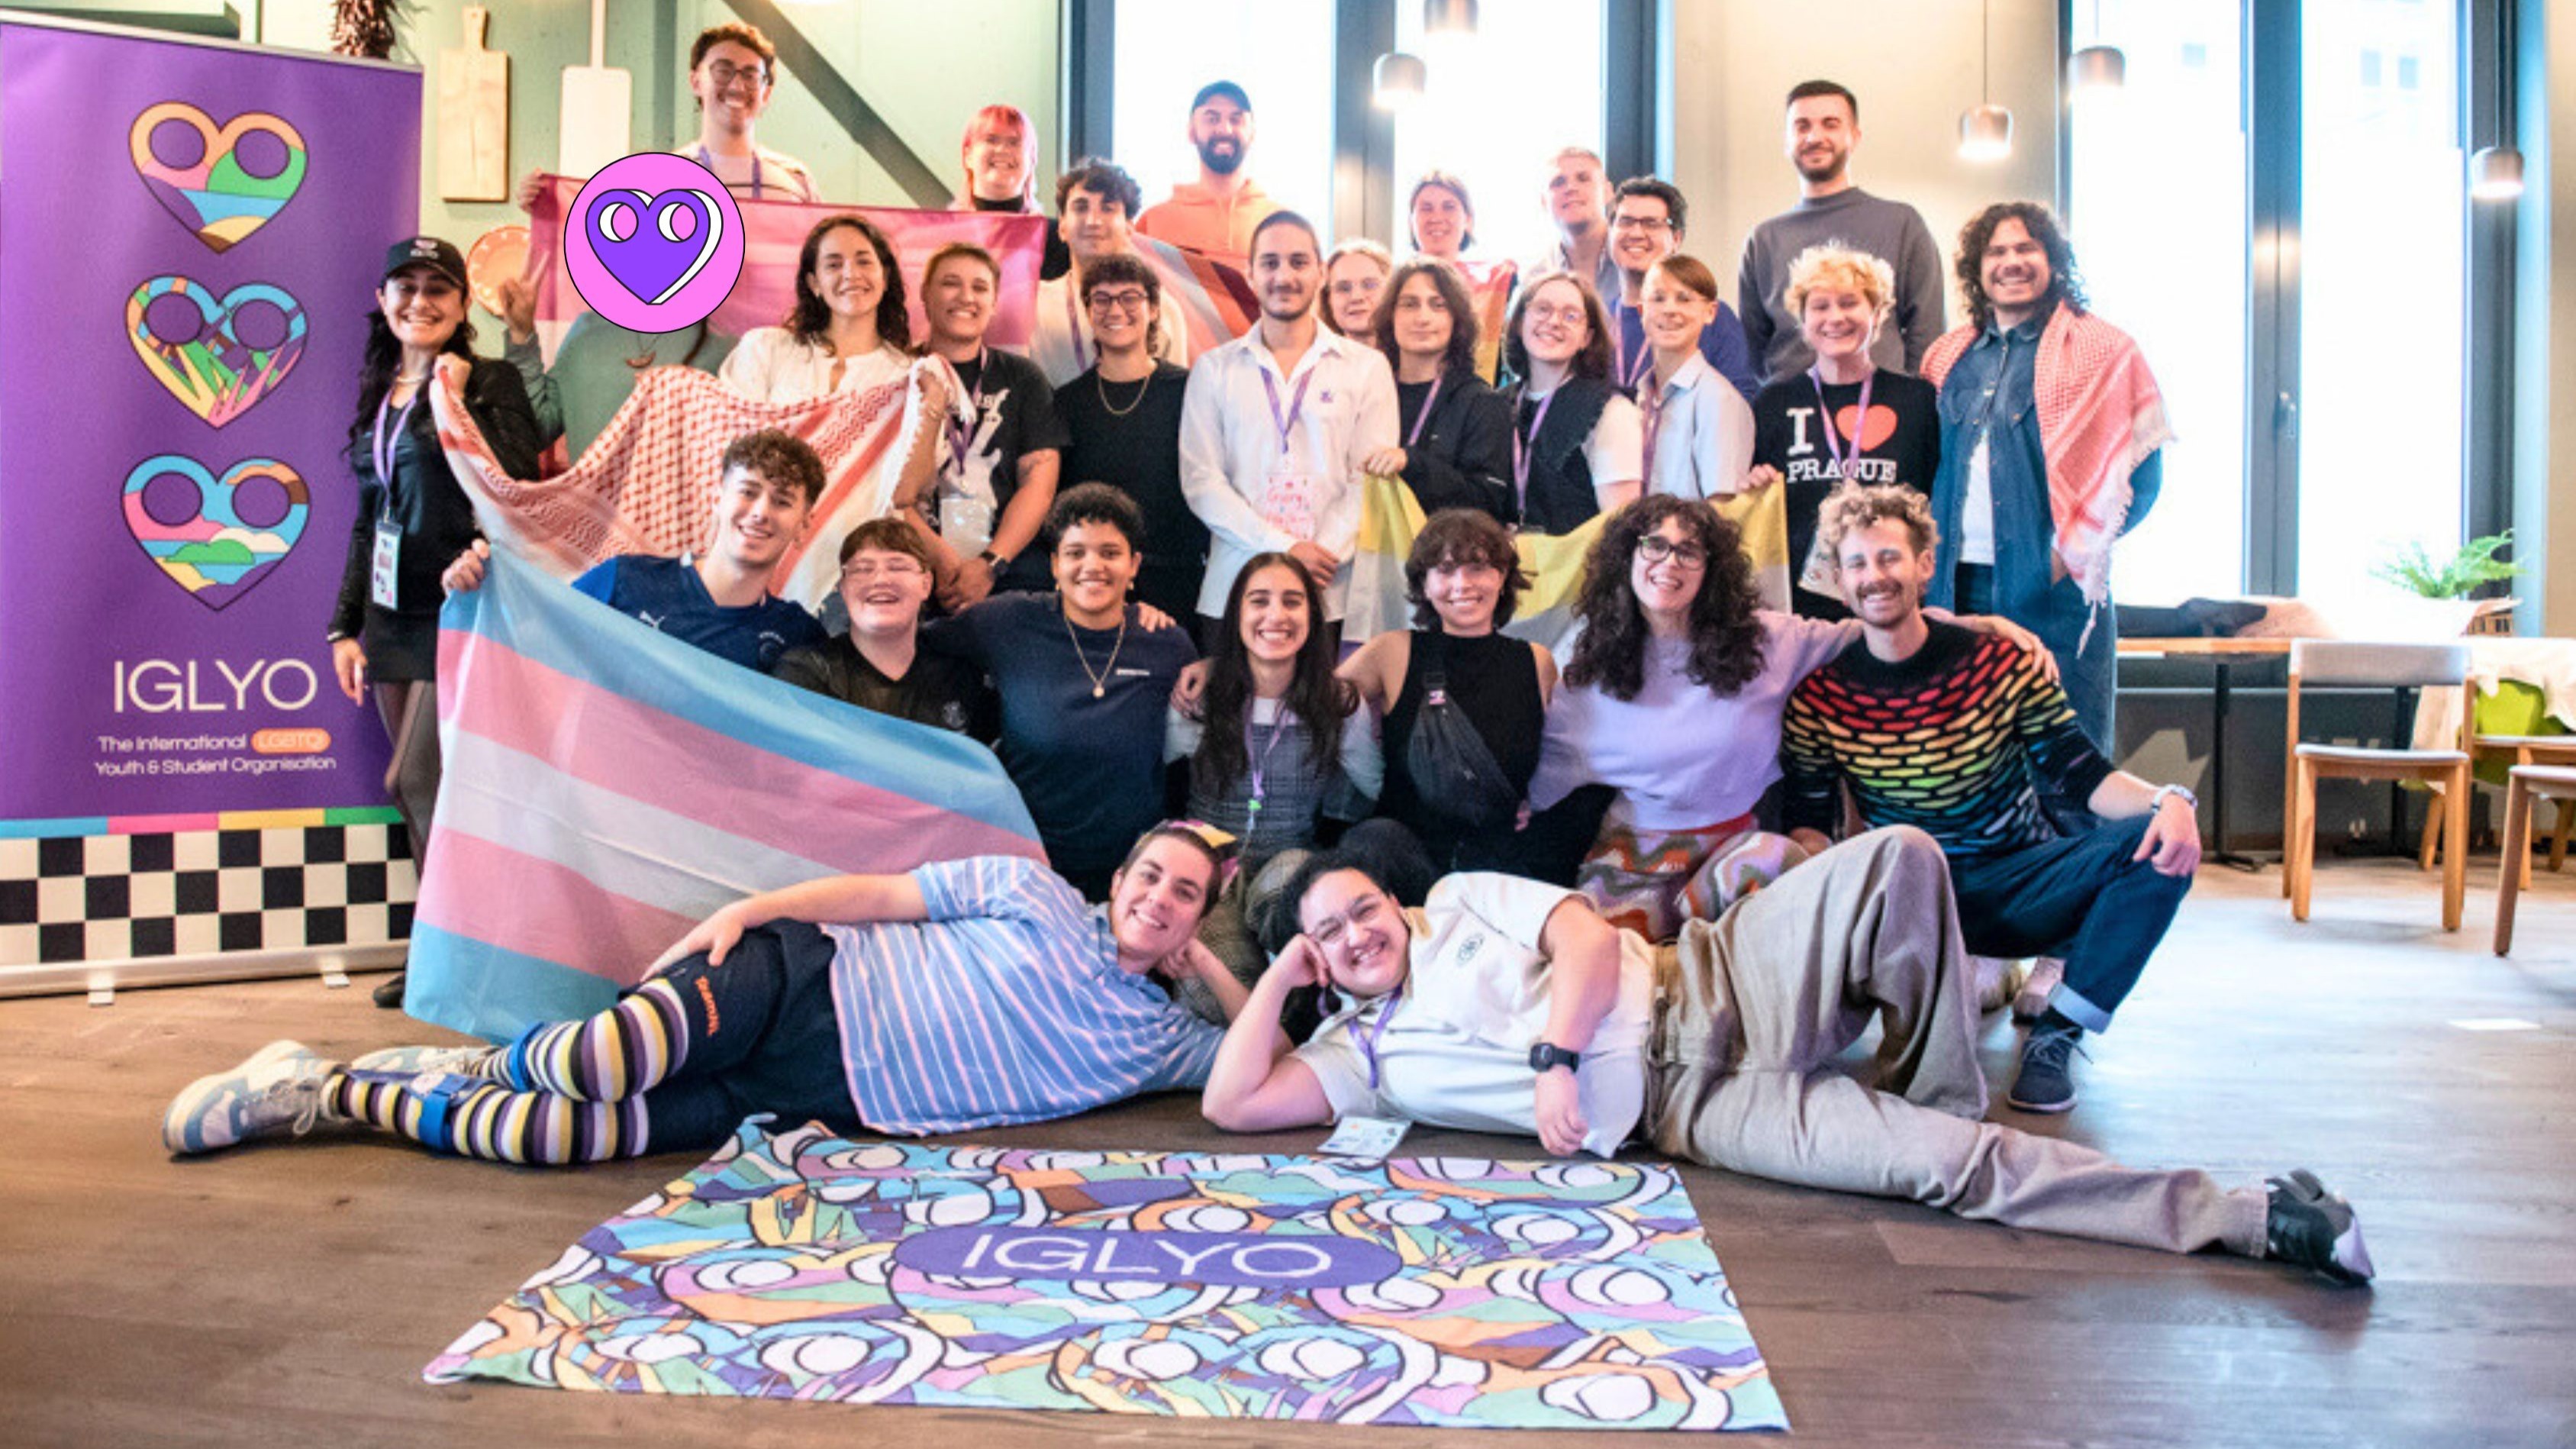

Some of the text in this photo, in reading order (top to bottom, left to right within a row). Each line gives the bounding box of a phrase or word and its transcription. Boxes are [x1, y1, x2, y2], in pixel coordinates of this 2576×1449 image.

[1786, 408, 1814, 456] I
[114, 659, 318, 712] IGLYO
[95, 755, 337, 776] Youth & Student Organisation
[98, 735, 133, 753] The
[136, 733, 247, 751] International
[962, 1234, 1332, 1279] IGLYO
